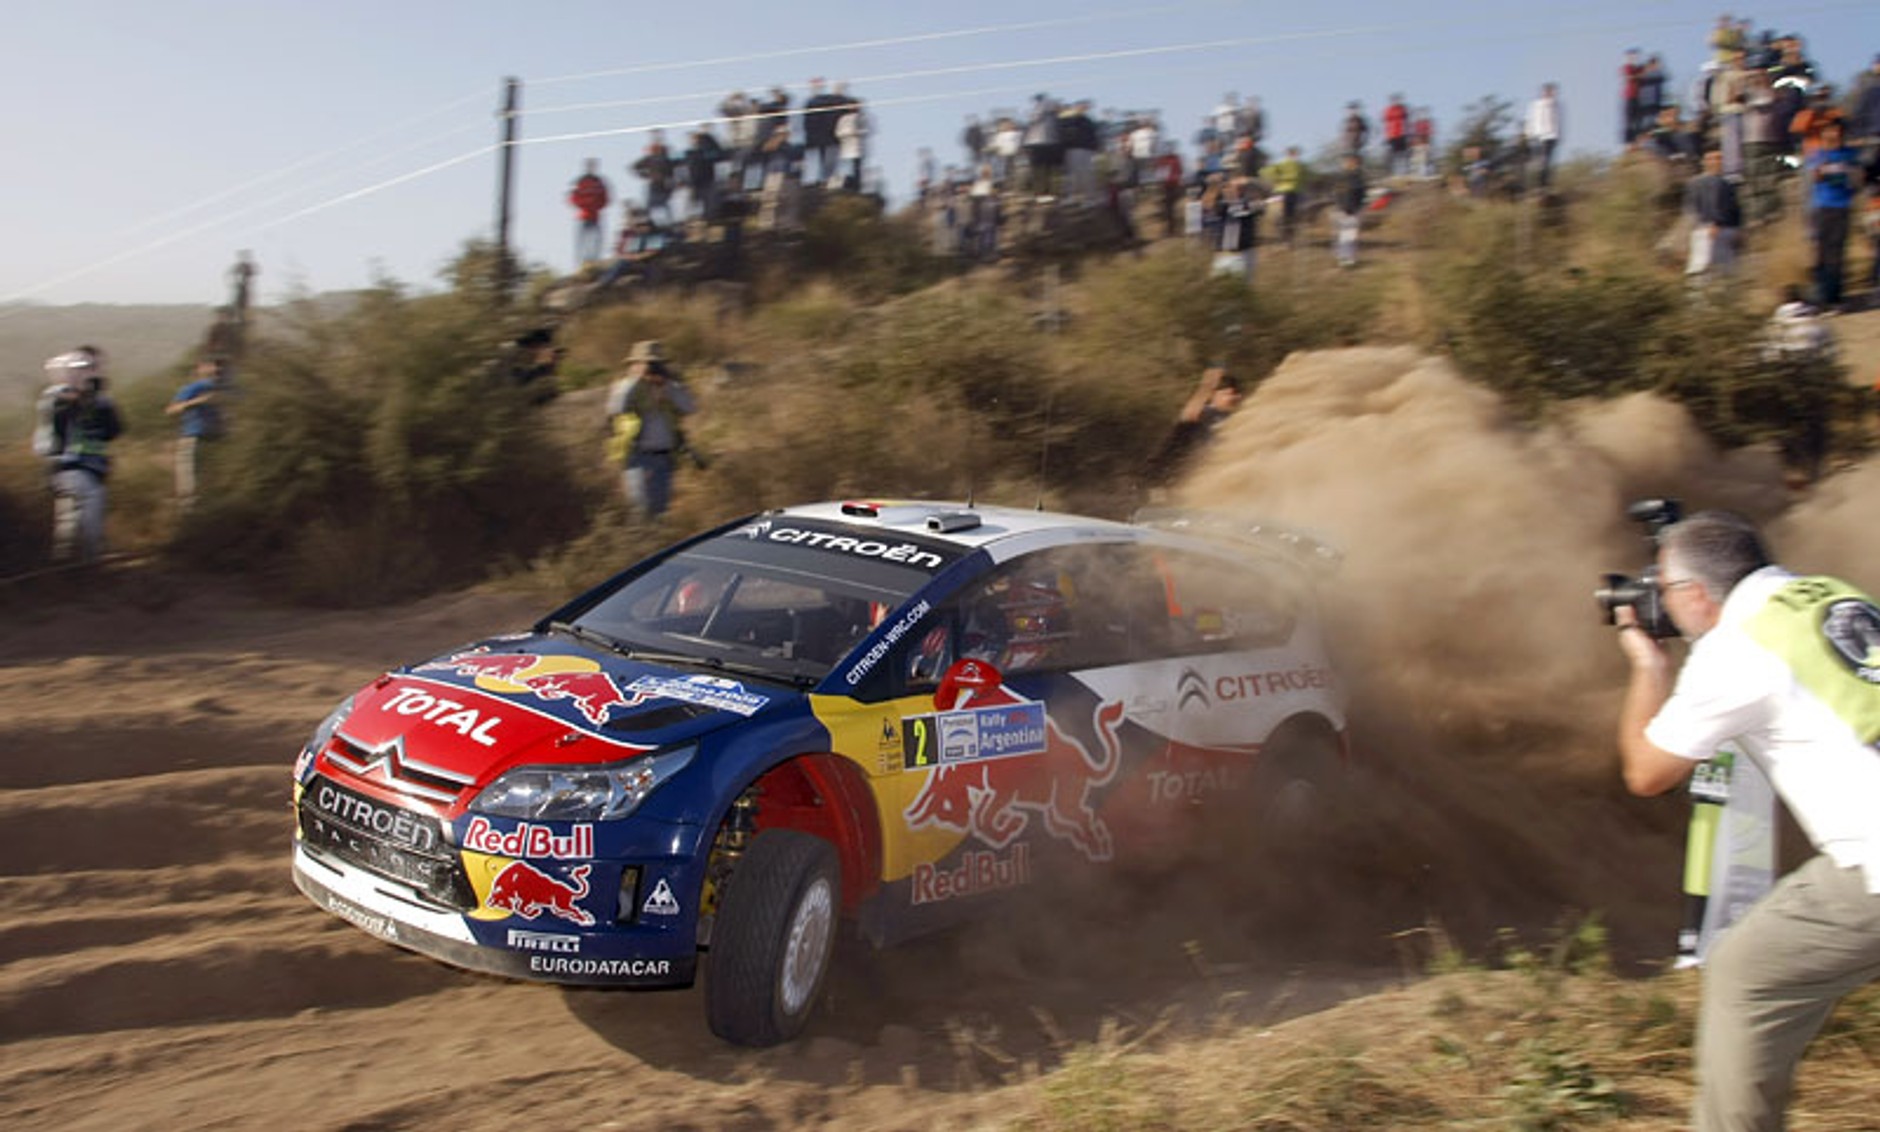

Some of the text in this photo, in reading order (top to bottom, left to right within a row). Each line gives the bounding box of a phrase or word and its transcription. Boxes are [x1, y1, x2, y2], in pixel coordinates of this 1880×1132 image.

[846, 599, 932, 685] CITROEN-WRC.COM
[381, 686, 502, 747] TOTAL
[913, 718, 928, 766] 2
[507, 928, 581, 952] PIRELLI
[530, 955, 671, 976] EURODATACAR
